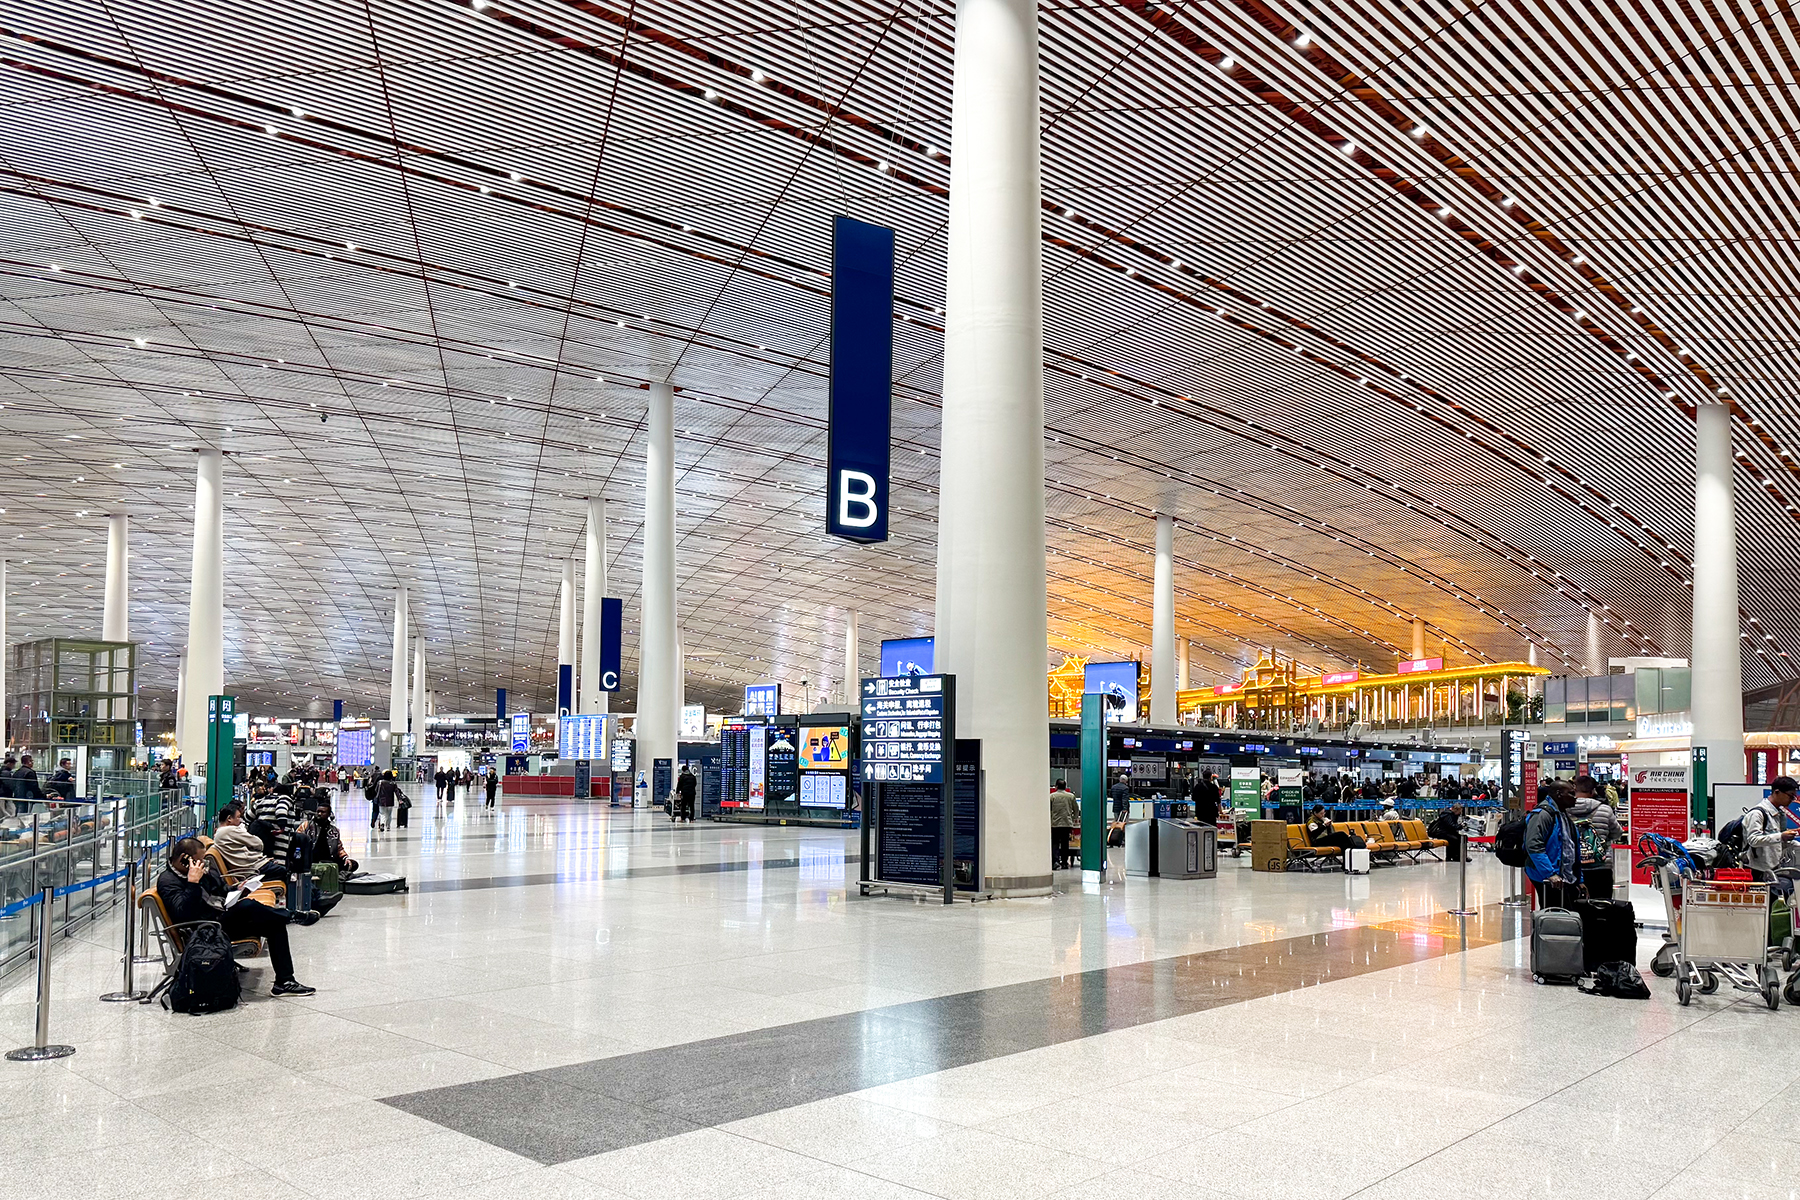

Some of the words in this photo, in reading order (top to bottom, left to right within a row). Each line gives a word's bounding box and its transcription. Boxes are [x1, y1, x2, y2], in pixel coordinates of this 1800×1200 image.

[839, 469, 878, 528] B
[602, 671, 617, 689] C
[560, 707, 569, 716] D
[498, 719, 504, 728] E
